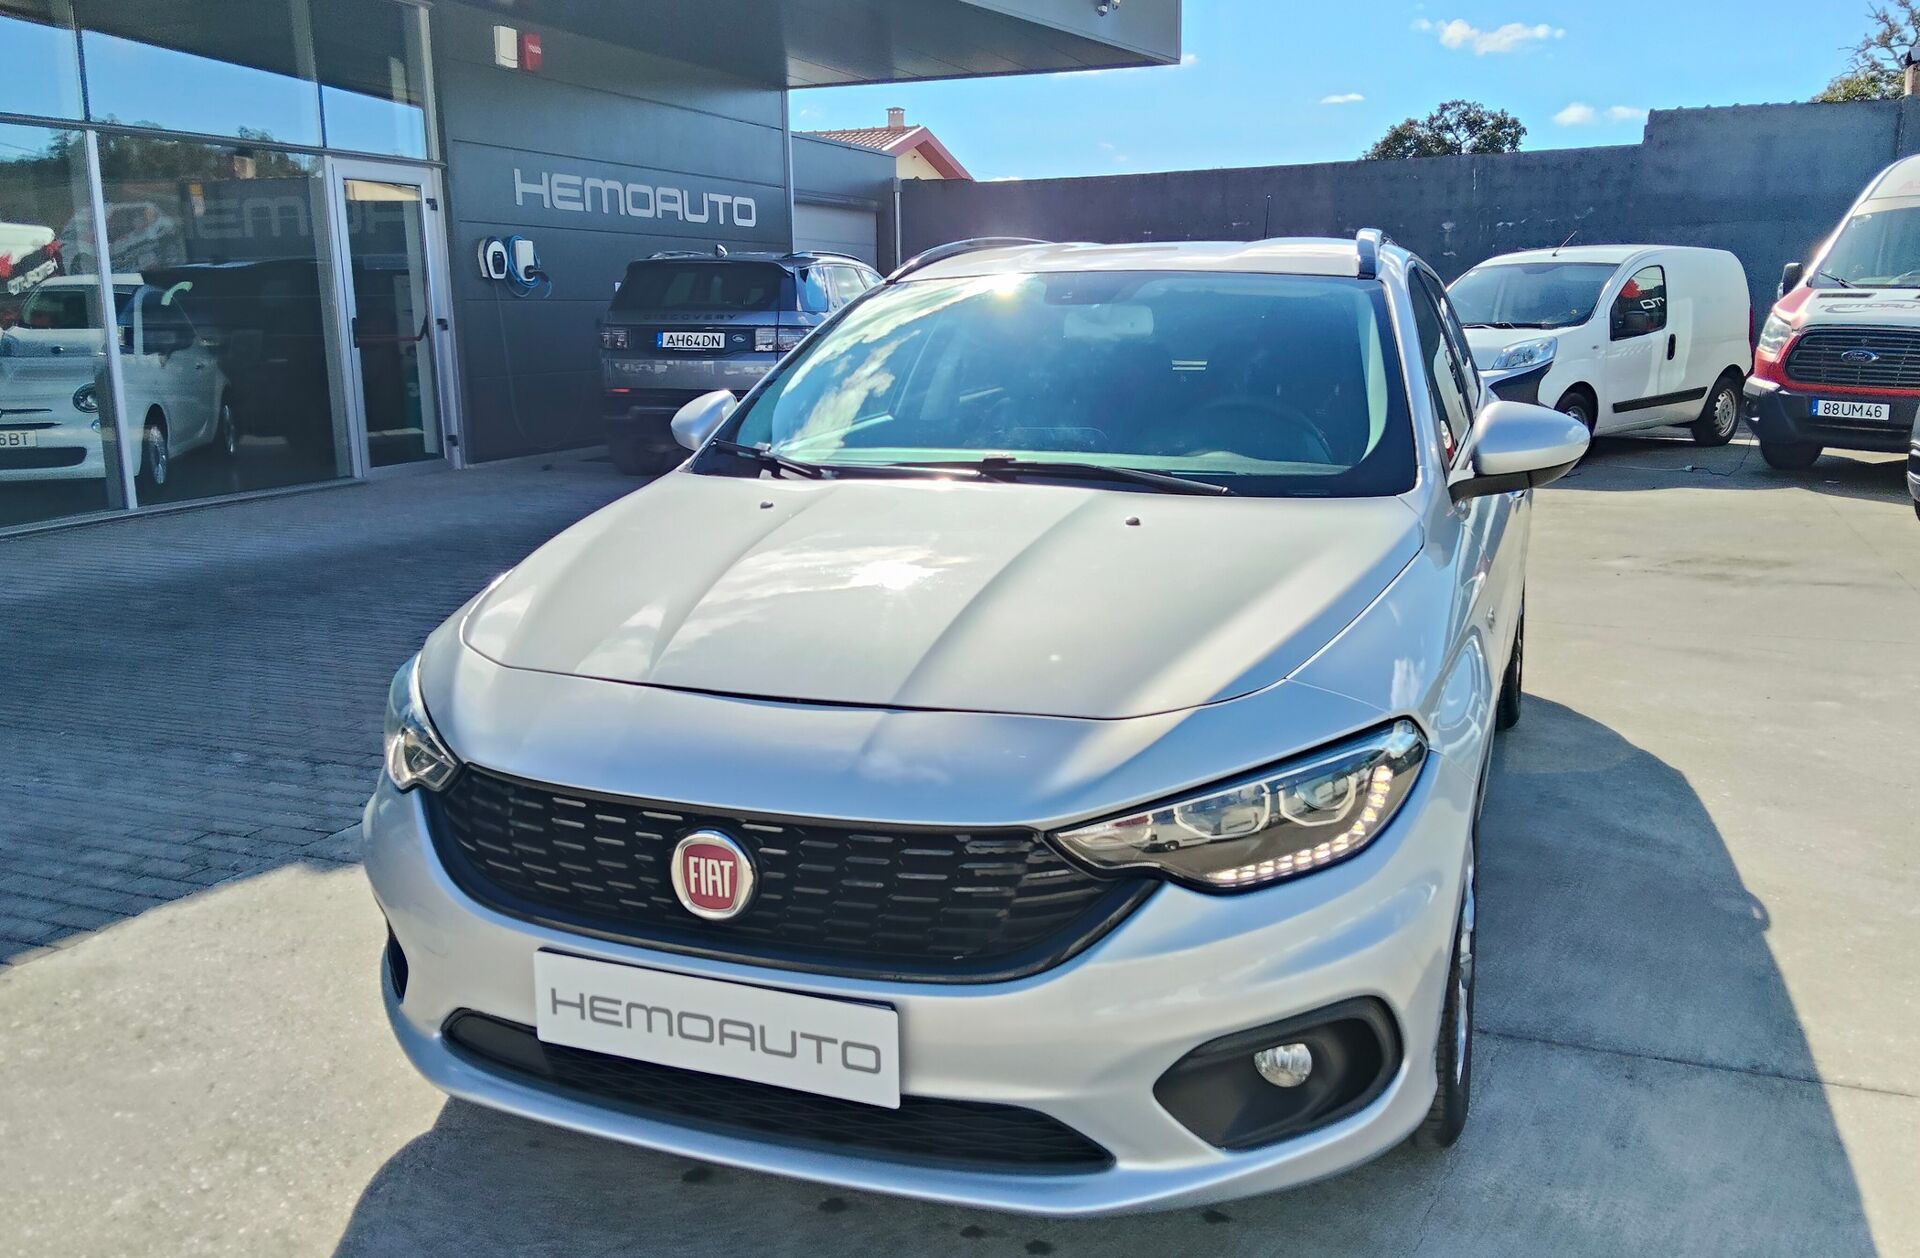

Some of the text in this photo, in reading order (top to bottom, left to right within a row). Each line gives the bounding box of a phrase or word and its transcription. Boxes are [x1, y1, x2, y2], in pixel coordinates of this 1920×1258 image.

[513, 168, 757, 228] HEMOAUTO
[642, 312, 738, 321] DISCOVERY
[666, 334, 721, 347] AH64DN
[1823, 402, 1883, 418] 88UM46
[687, 854, 735, 899] FIAT
[550, 987, 882, 1075] HEMOAUTO
